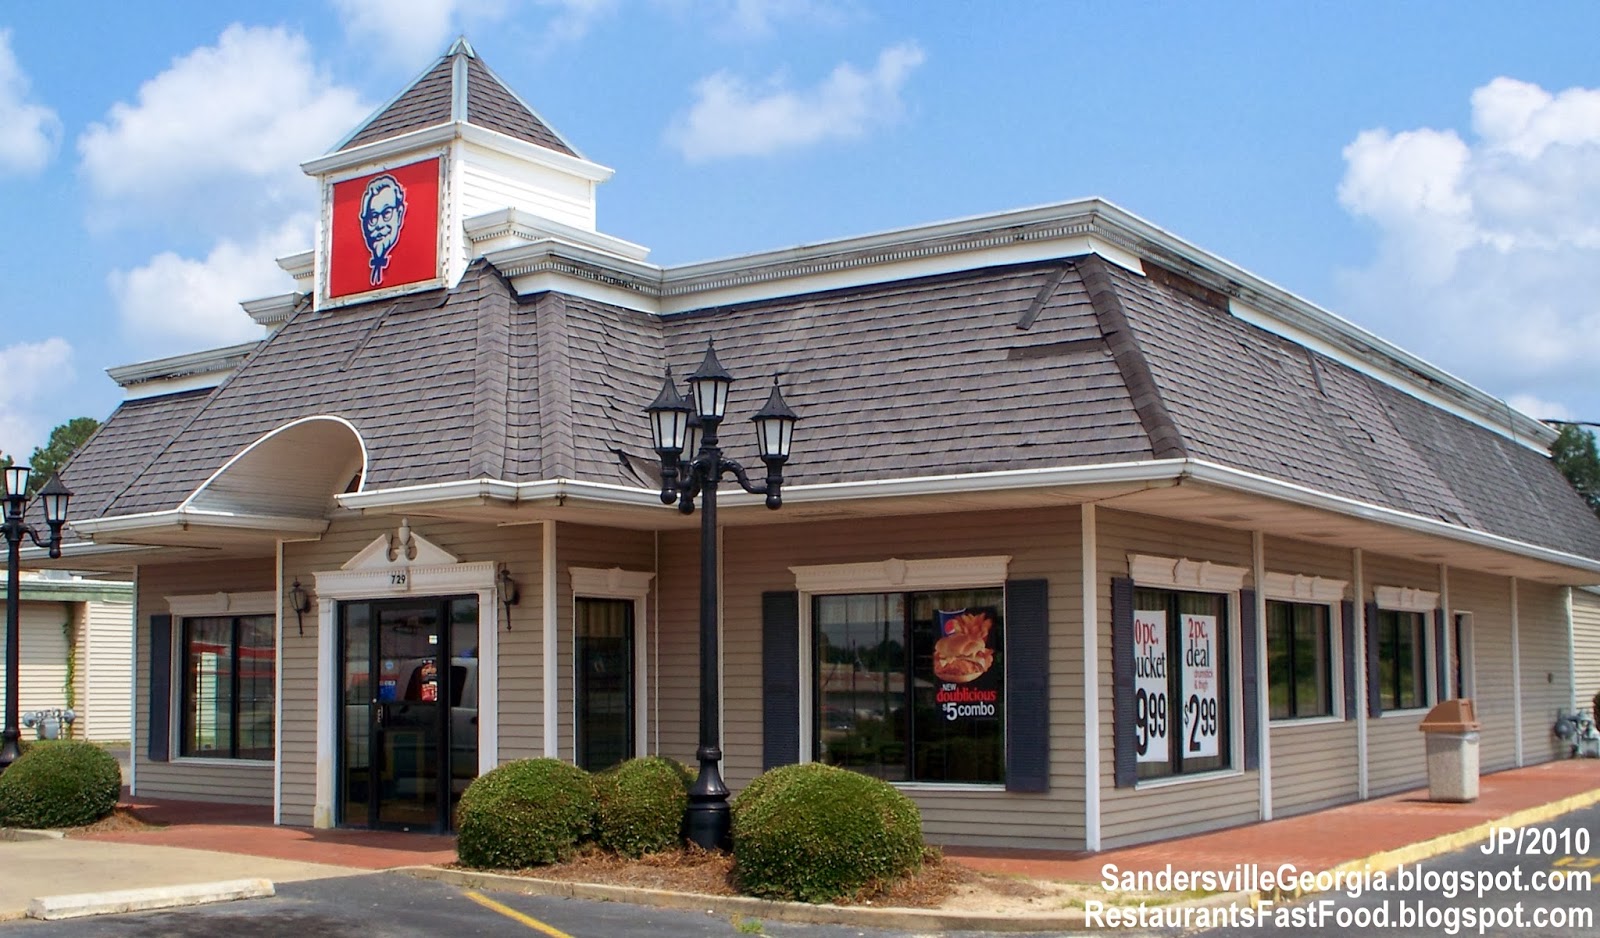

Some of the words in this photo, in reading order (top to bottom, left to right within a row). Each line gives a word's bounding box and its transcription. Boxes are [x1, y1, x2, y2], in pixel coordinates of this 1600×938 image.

[391, 574, 406, 584] 729
[1186, 639, 1210, 667] deal
[1135, 646, 1166, 679] ucket
[942, 683, 957, 692] NEW
[937, 688, 995, 701] doublicious
